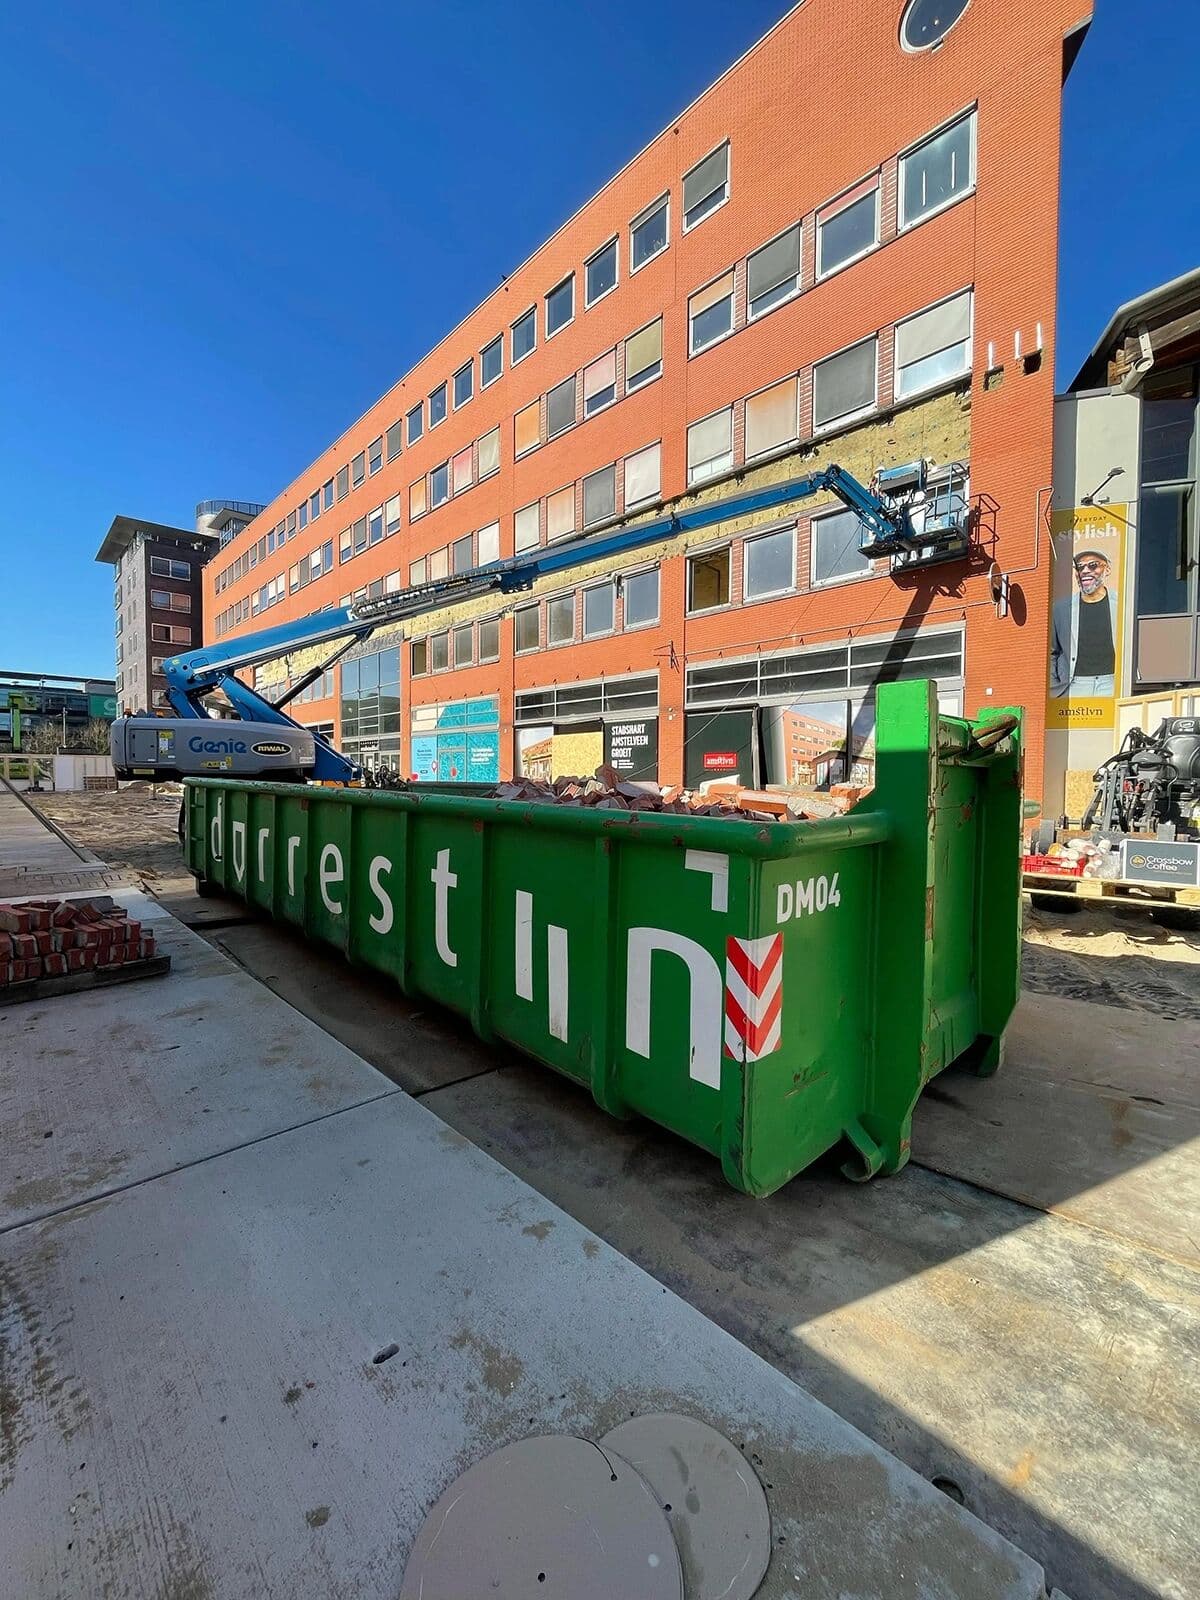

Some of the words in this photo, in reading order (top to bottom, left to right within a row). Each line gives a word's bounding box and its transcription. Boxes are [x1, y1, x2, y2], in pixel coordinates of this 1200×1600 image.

[1058, 521, 1118, 544] stylish
[1058, 706, 1103, 716] amstlvn
[611, 723, 646, 736] STADSHART
[188, 736, 248, 754] Genie
[611, 735, 649, 747] AMSTELVEEN
[257, 745, 288, 753] RIWAL
[611, 747, 632, 758] GROEIT
[1146, 855, 1194, 866] Crossbow
[1146, 861, 1178, 872] Coffee
[776, 872, 841, 924] DM04
